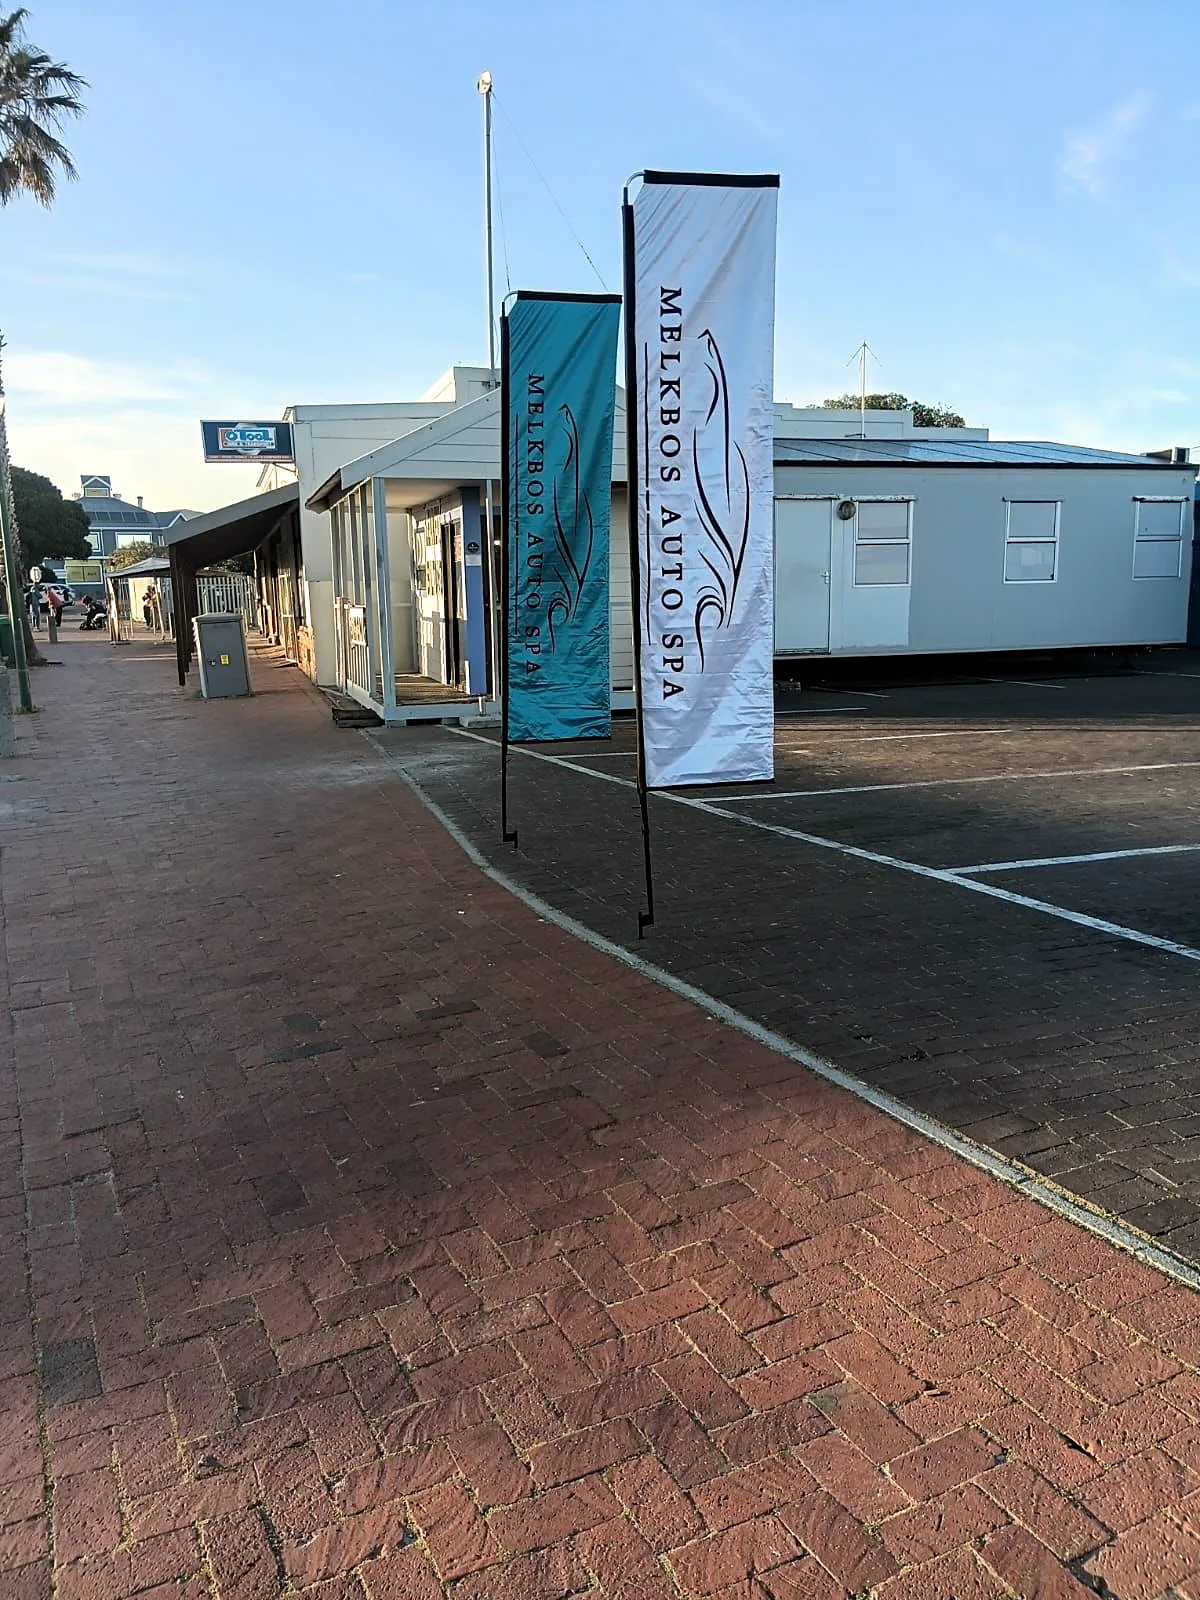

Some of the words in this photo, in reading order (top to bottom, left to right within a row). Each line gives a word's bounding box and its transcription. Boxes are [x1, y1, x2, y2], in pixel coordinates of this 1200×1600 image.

[659, 285, 683, 482] MELKBOS
[526, 373, 545, 516] MELKBOS
[525, 533, 544, 609] AUTO
[660, 505, 684, 611] AUTO
[525, 627, 542, 676] SPA
[661, 633, 685, 701] SPA
